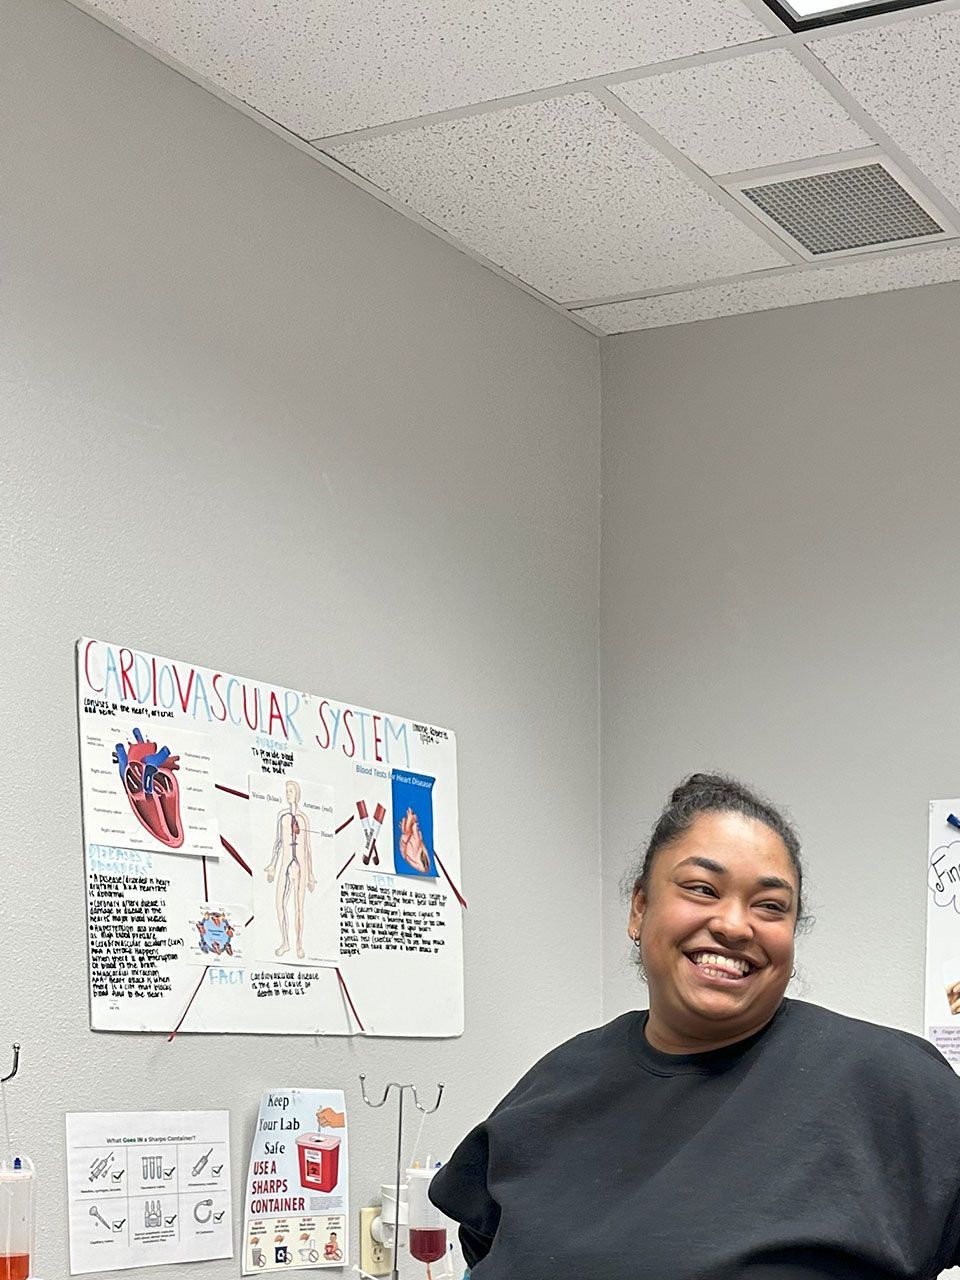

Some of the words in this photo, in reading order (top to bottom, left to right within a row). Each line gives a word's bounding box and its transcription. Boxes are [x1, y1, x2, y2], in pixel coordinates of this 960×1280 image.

[85, 640, 302, 745] CARDIOVASCULAR
[315, 701, 410, 768] SYSTEM
[356, 764, 372, 776] Blood
[374, 768, 388, 778] Tests
[396, 774, 412, 785] Heart
[412, 778, 432, 788] Disease
[209, 968, 244, 984] FACT
[267, 1094, 290, 1110] Keep
[258, 1118, 278, 1132] Your
[280, 1118, 300, 1130] Lab
[264, 1142, 286, 1155] Safe
[253, 1161, 269, 1175] USE
[270, 1160, 276, 1174] A
[252, 1179, 288, 1194] SHARPS
[250, 1197, 305, 1214] CONTAINER
